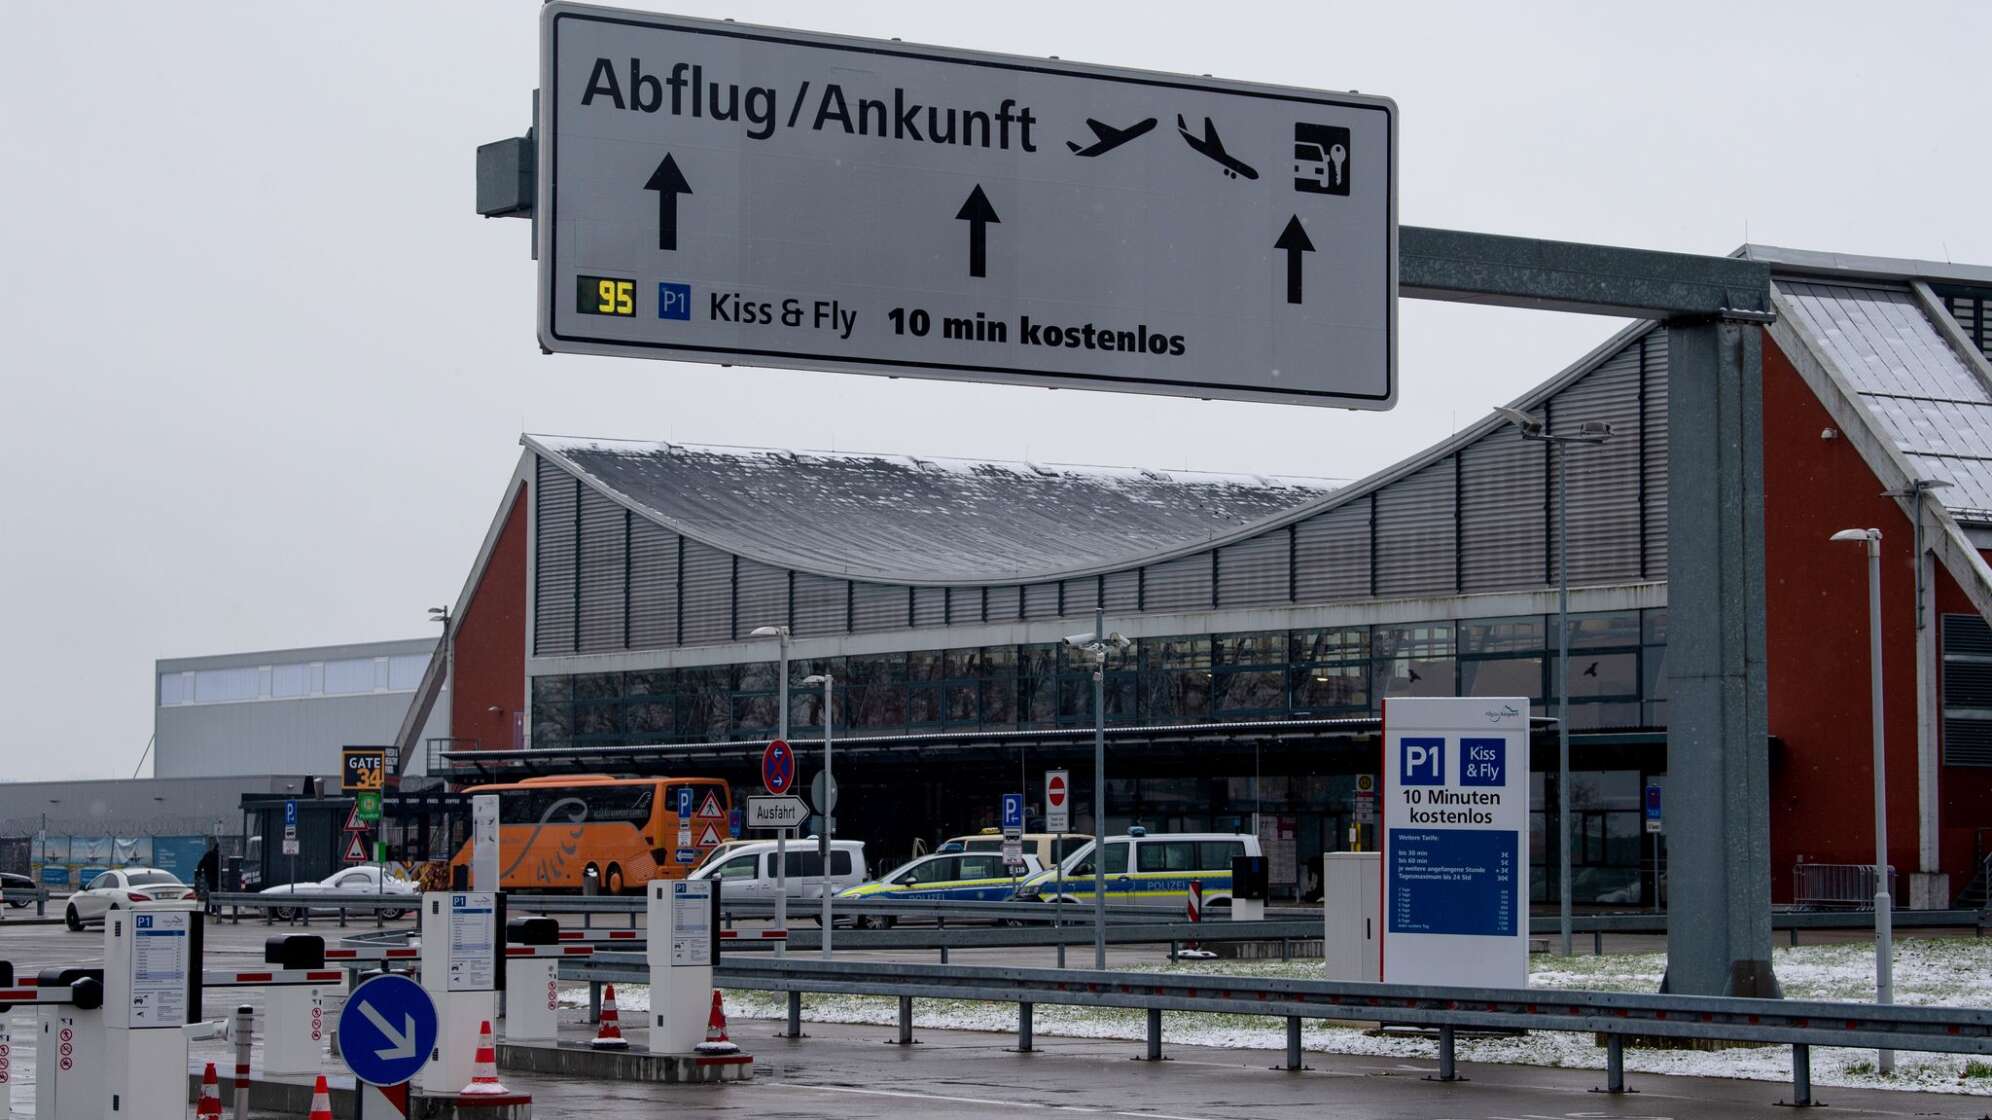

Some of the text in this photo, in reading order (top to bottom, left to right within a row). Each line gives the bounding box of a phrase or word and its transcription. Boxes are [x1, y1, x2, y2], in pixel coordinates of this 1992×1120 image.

[598, 279, 633, 314] 95
[662, 289, 686, 313] P1
[711, 292, 1186, 356] Kiss & Fly 10 min kostenlos
[1406, 745, 1439, 777] P1
[1470, 746, 1496, 761] Kiss
[348, 757, 381, 769] GATE
[1466, 762, 1500, 781] & Fly
[356, 768, 381, 787] 34
[1403, 788, 1501, 805] 10 Minuten
[756, 804, 796, 820] Ausfahrt
[1409, 806, 1493, 824] kostenlos
[1147, 880, 1186, 890] POLIZEI
[138, 917, 151, 926] P1
